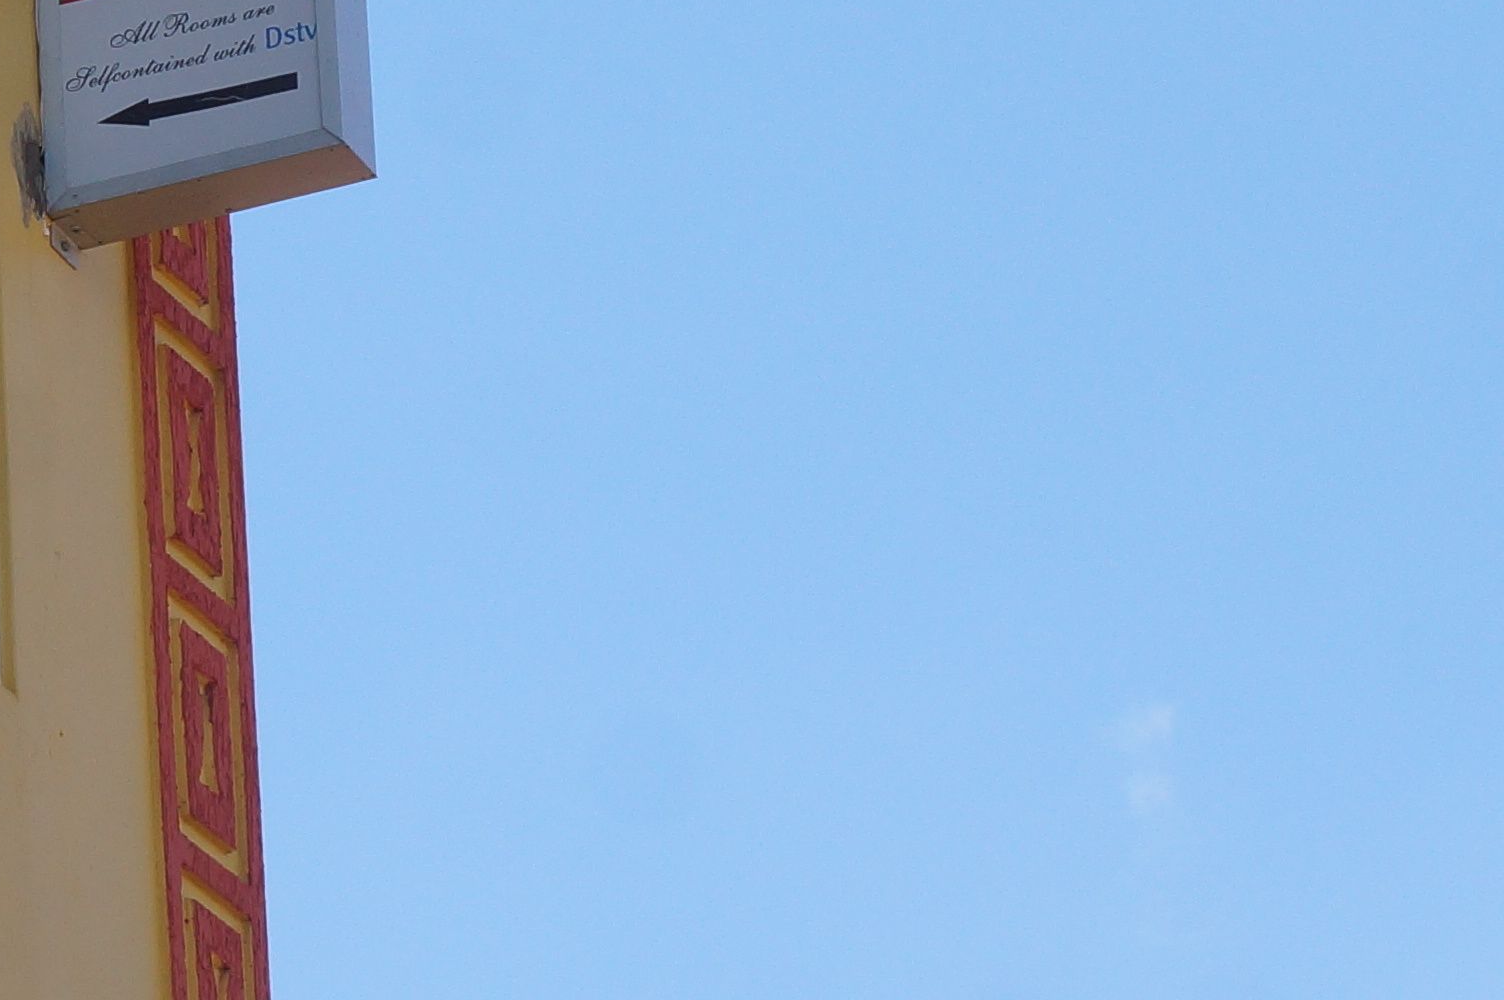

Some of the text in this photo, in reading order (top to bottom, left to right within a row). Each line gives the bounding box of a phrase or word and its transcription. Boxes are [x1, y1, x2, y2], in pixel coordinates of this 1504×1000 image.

[110, 4, 276, 49] All Rooms are
[65, 22, 318, 93] Selfcontained with Dstv
